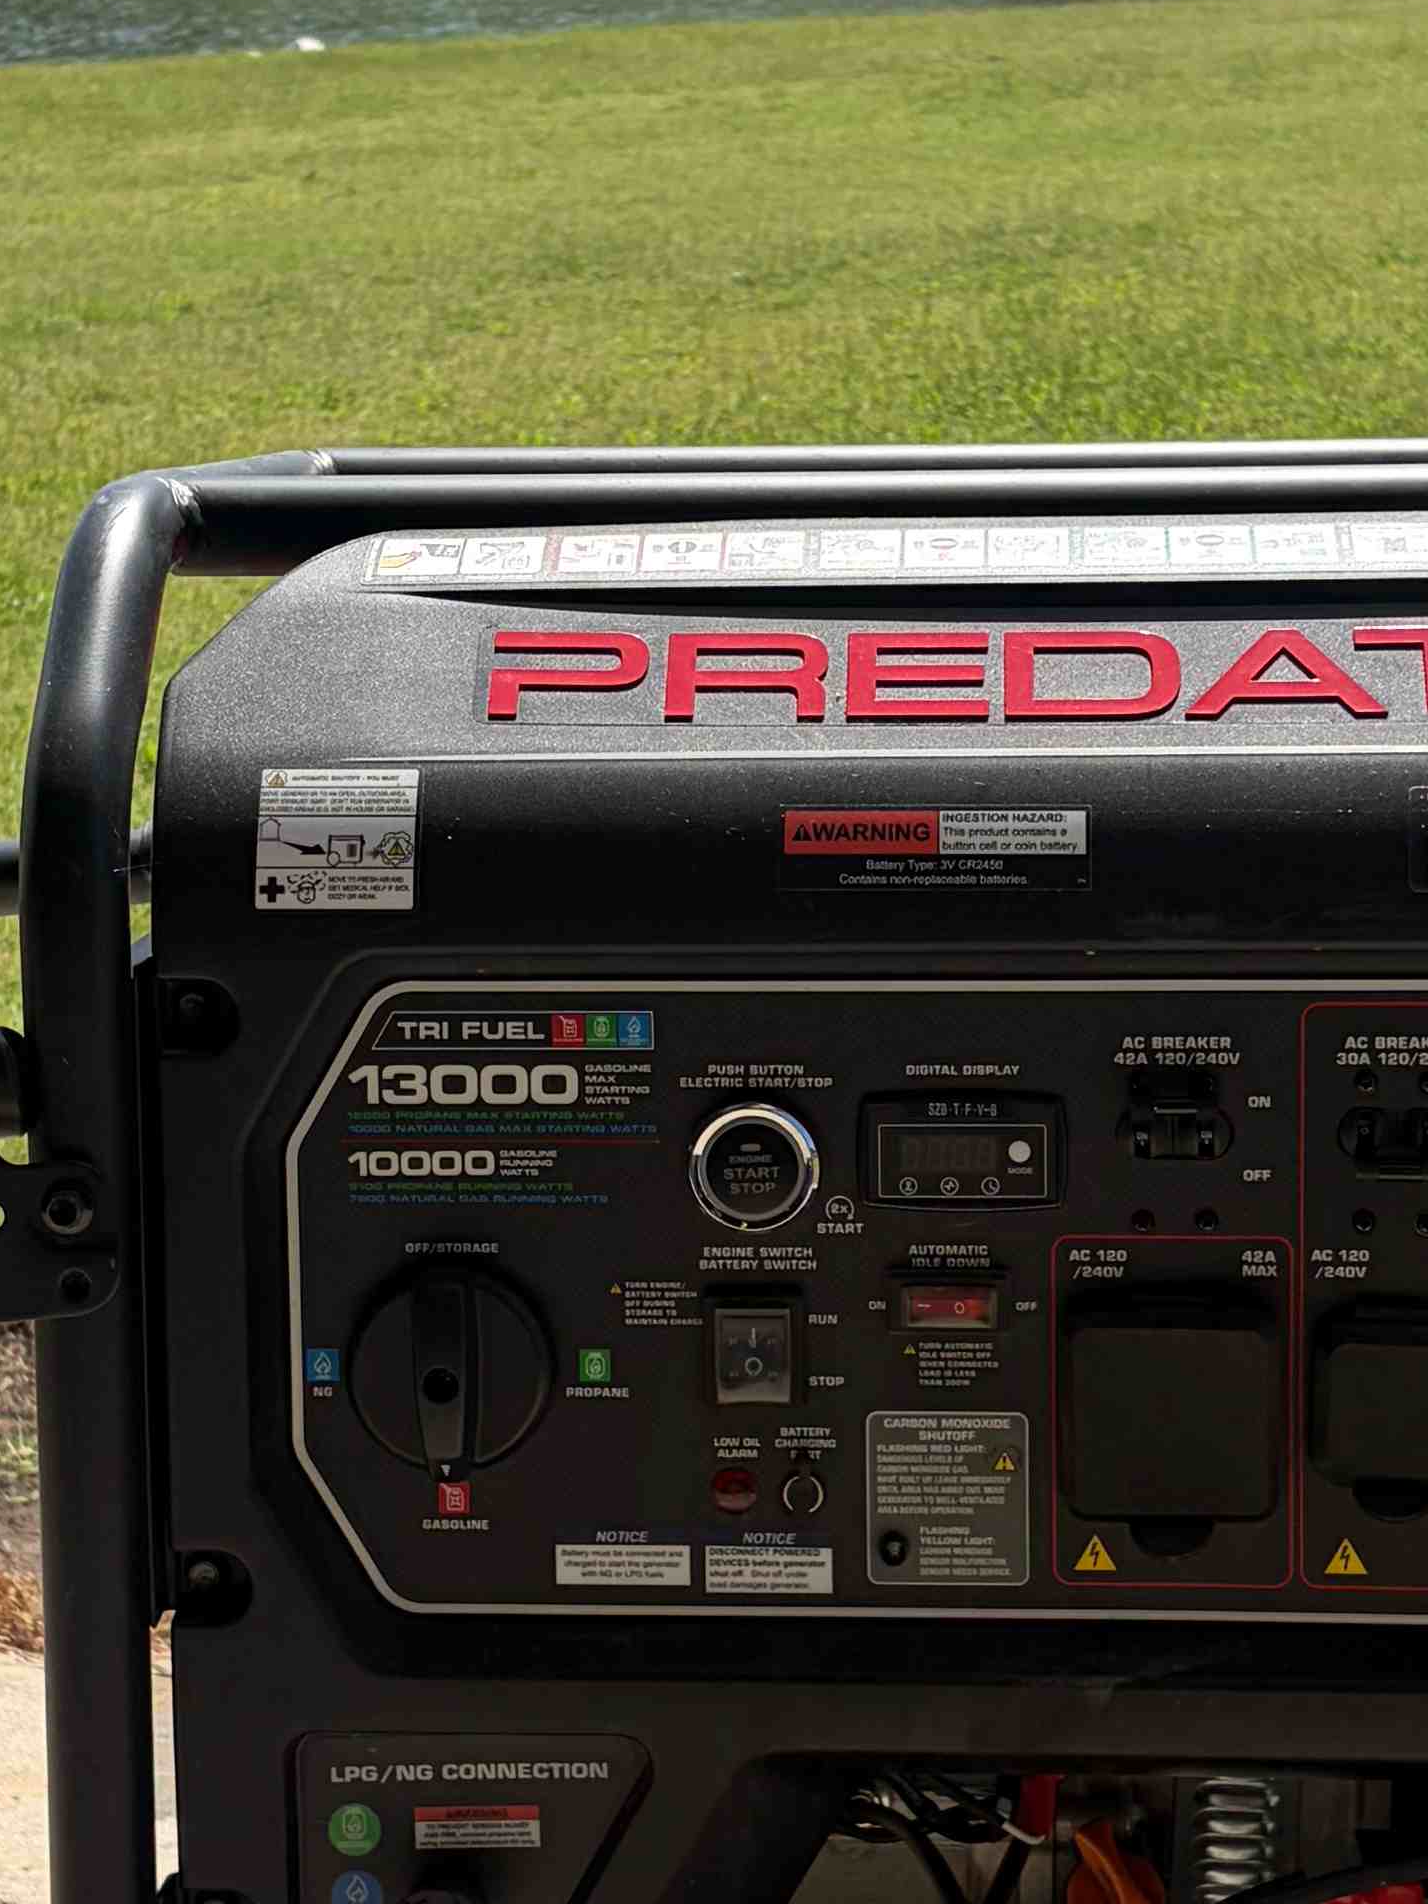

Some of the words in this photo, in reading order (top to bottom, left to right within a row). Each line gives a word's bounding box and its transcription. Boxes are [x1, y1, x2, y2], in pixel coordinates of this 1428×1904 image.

[942, 813, 1009, 823] INGESTION
[1012, 813, 1068, 824] HAZARD:
[812, 823, 930, 841] WARNING
[944, 827, 965, 837] This
[969, 827, 1009, 838] product
[1012, 827, 1057, 837] contains
[1060, 829, 1067, 837] a
[942, 841, 976, 851] button
[979, 841, 997, 851] cell
[1001, 843, 1011, 851] or
[1014, 841, 1037, 851] coin
[866, 858, 906, 872] Battery
[908, 858, 937, 872] Type:
[940, 859, 956, 871] 3V
[959, 859, 1003, 871] CR2450
[839, 872, 888, 885] Contains
[890, 873, 977, 887] non-replaceable
[397, 1021, 448, 1040] TRI
[462, 1021, 545, 1040] FUEL
[1122, 1036, 1146, 1049] AC
[1152, 1036, 1232, 1049] BREAKER
[1344, 1036, 1368, 1049] AC
[1114, 1052, 1149, 1066] 42A
[1156, 1052, 1241, 1066] 120/240V
[1336, 1052, 1371, 1066] 30A
[584, 1064, 652, 1074] GASOLINE
[708, 1064, 745, 1075] PUSH
[749, 1064, 804, 1075] BUTTON
[905, 1064, 958, 1076] DIGITAL
[962, 1064, 1020, 1076] DISPLAY
[348, 1064, 579, 1105] 13000
[584, 1075, 616, 1084] MAX
[680, 1076, 744, 1088] ELECTRIC
[748, 1076, 833, 1088] START/STOP
[584, 1085, 650, 1095] STARTING
[584, 1096, 631, 1105] WATTS
[1248, 1096, 1271, 1108] ON
[499, 1149, 558, 1158] GASOLINE
[728, 1154, 772, 1163] ENGINE
[348, 1150, 496, 1177] 10000
[499, 1159, 554, 1168] RUNNING
[499, 1169, 540, 1177] WATTS
[723, 1166, 781, 1180] START
[1243, 1169, 1272, 1182] OFF
[730, 1182, 776, 1195] STOP
[816, 1222, 865, 1234] START
[405, 1243, 500, 1254] OFF/STORAGE
[703, 1247, 754, 1258] ENGINE
[759, 1247, 813, 1258] SWITCH
[908, 1244, 988, 1256] AUTOMATIC
[1069, 1249, 1093, 1262] AC
[1096, 1249, 1128, 1262] 120
[1241, 1250, 1276, 1263] 42A
[1311, 1249, 1333, 1262] AC
[1338, 1249, 1370, 1262] 120
[699, 1259, 758, 1270] BATTERY
[764, 1259, 817, 1271] SWITCH
[911, 1257, 941, 1267] IDLE
[946, 1257, 990, 1267] DOWN
[1072, 1265, 1124, 1279] /240V
[1241, 1265, 1277, 1278] MAX
[1315, 1265, 1367, 1279] /240V
[868, 1300, 887, 1311] ON
[1014, 1301, 1038, 1312] OFF
[808, 1314, 838, 1324] RUN
[809, 1376, 845, 1387] STOP
[313, 1387, 332, 1397] NG
[565, 1387, 630, 1398] PROPANE
[883, 1417, 939, 1429] CARBON
[941, 1417, 1012, 1430] MONOXIDE
[779, 1426, 831, 1437] BATTERY
[918, 1430, 977, 1441] SHUTOFF
[714, 1437, 741, 1447] LOW
[742, 1437, 761, 1447] OIL
[774, 1438, 837, 1449] CHARGING
[716, 1448, 759, 1459] ALARM
[422, 1519, 489, 1531] GASOLINE
[595, 1530, 649, 1544] NOTICE
[742, 1532, 797, 1545] NOTICE
[330, 1763, 434, 1783] LPG/NG
[442, 1761, 609, 1781] CONNECTION
